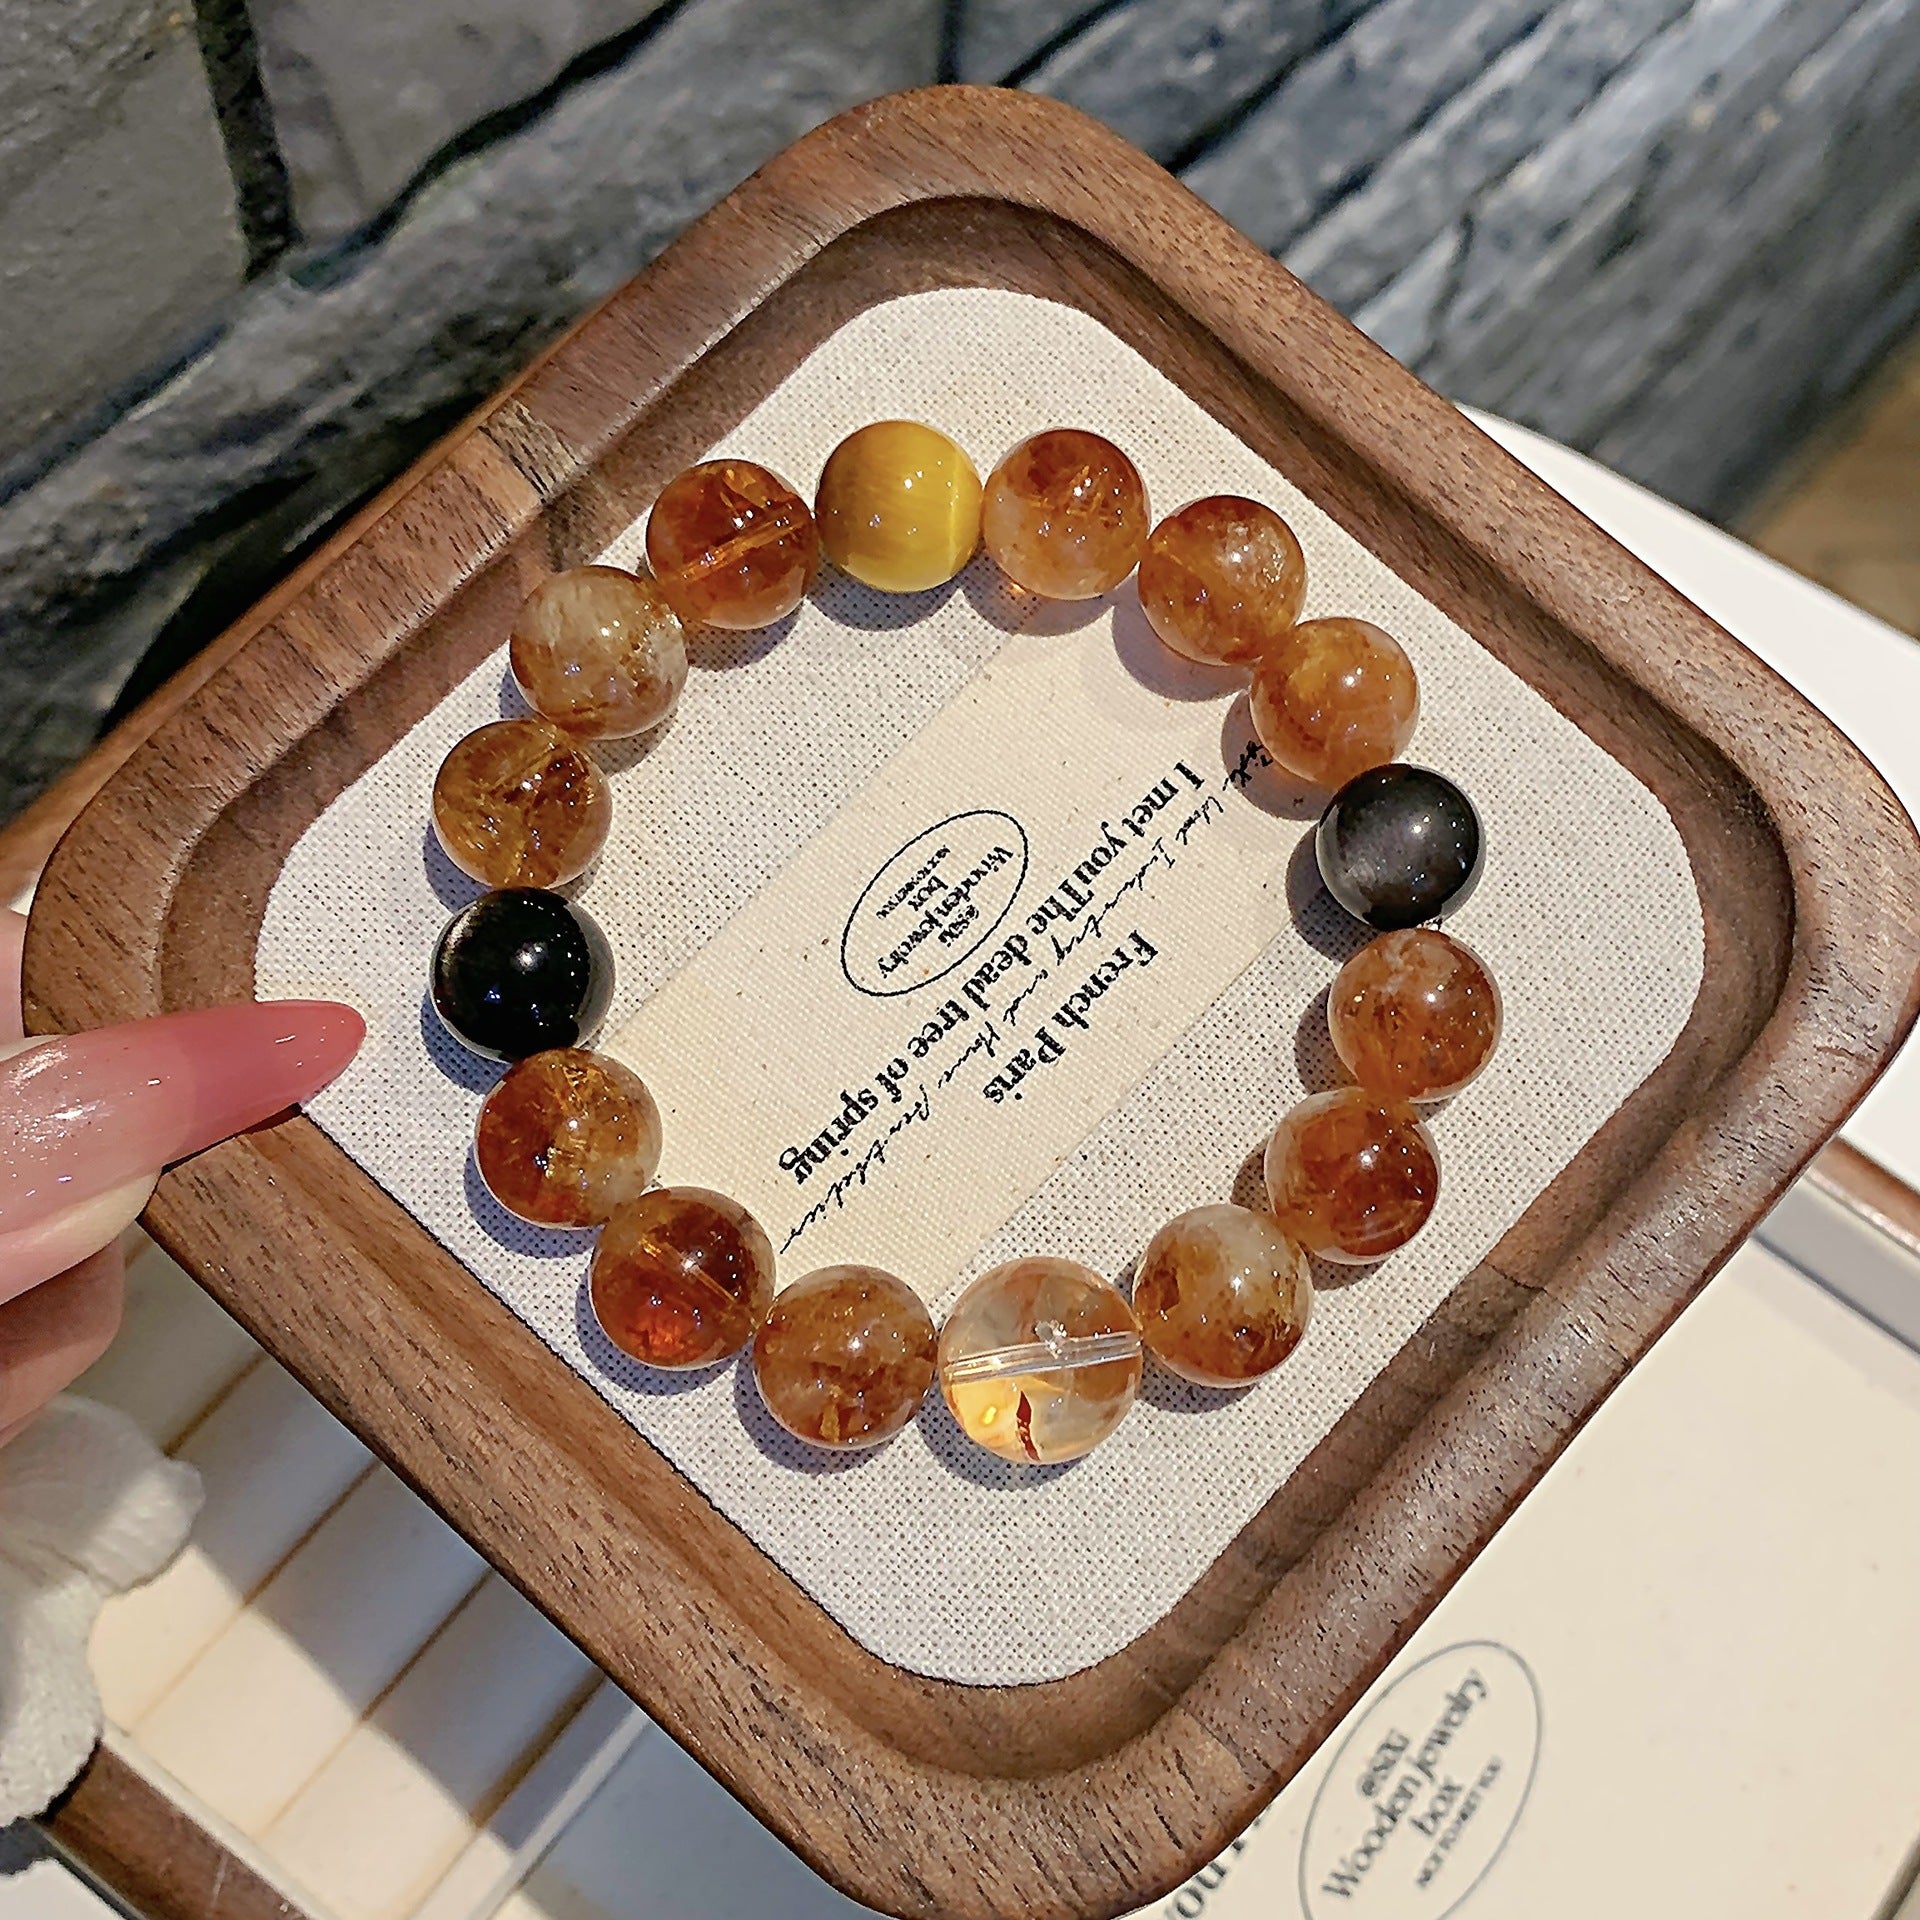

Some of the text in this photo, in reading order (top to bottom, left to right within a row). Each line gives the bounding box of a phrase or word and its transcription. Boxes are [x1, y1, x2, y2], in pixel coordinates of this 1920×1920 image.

[1174, 761, 1205, 790] I
[1122, 778, 1179, 837] met
[908, 876, 948, 911] box
[962, 934, 1032, 1011] dead
[908, 1000, 969, 1058] tree
[983, 930, 1158, 1103] French Paris
[875, 1058, 908, 1103] of
[779, 1089, 878, 1184] spring
[1410, 1778, 1462, 1837] box
